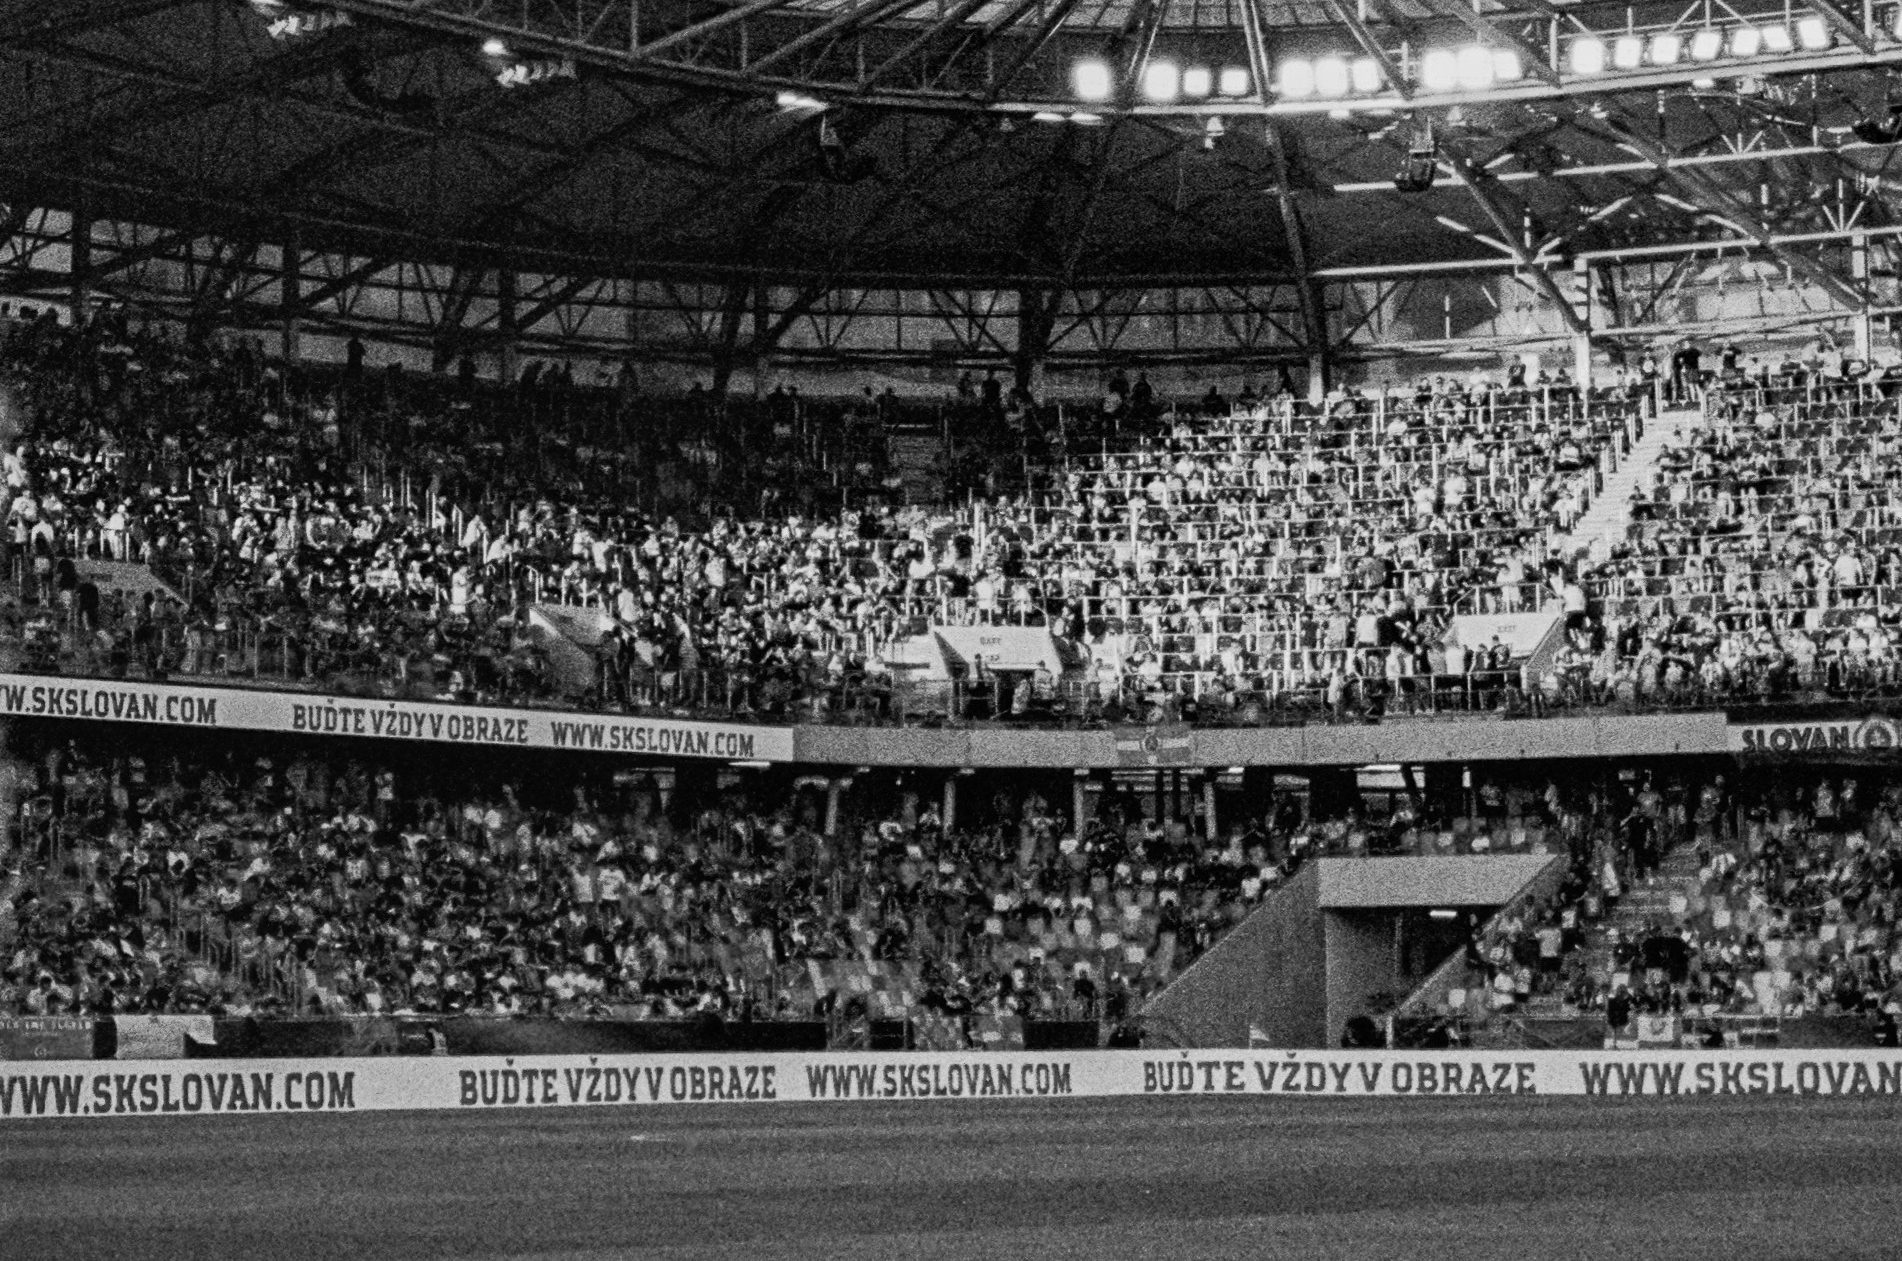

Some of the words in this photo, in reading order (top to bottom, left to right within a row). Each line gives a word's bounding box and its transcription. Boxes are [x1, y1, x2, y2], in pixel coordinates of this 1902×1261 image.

[0, 684, 217, 724] W.SKSLOVAN.COM
[292, 698, 366, 733] BUĎTE
[370, 702, 426, 738] VŽDY
[429, 712, 444, 738] V
[448, 714, 529, 743] OBRAZE
[550, 720, 756, 759] WWW.SKSLOVAN.COM
[1741, 725, 1849, 752] SLOVAN
[459, 1057, 558, 1106] BUĎTE
[564, 1056, 640, 1102] VŽDY
[644, 1065, 664, 1101] V
[670, 1065, 777, 1101] OBRAZE
[805, 1061, 1072, 1099] WWW.SKSLOVAN.COM
[1143, 1050, 1246, 1093] BUĎTE
[1254, 1050, 1352, 1093] VŽDY
[1357, 1061, 1383, 1093] V
[1392, 1061, 1537, 1094] OBRAZE
